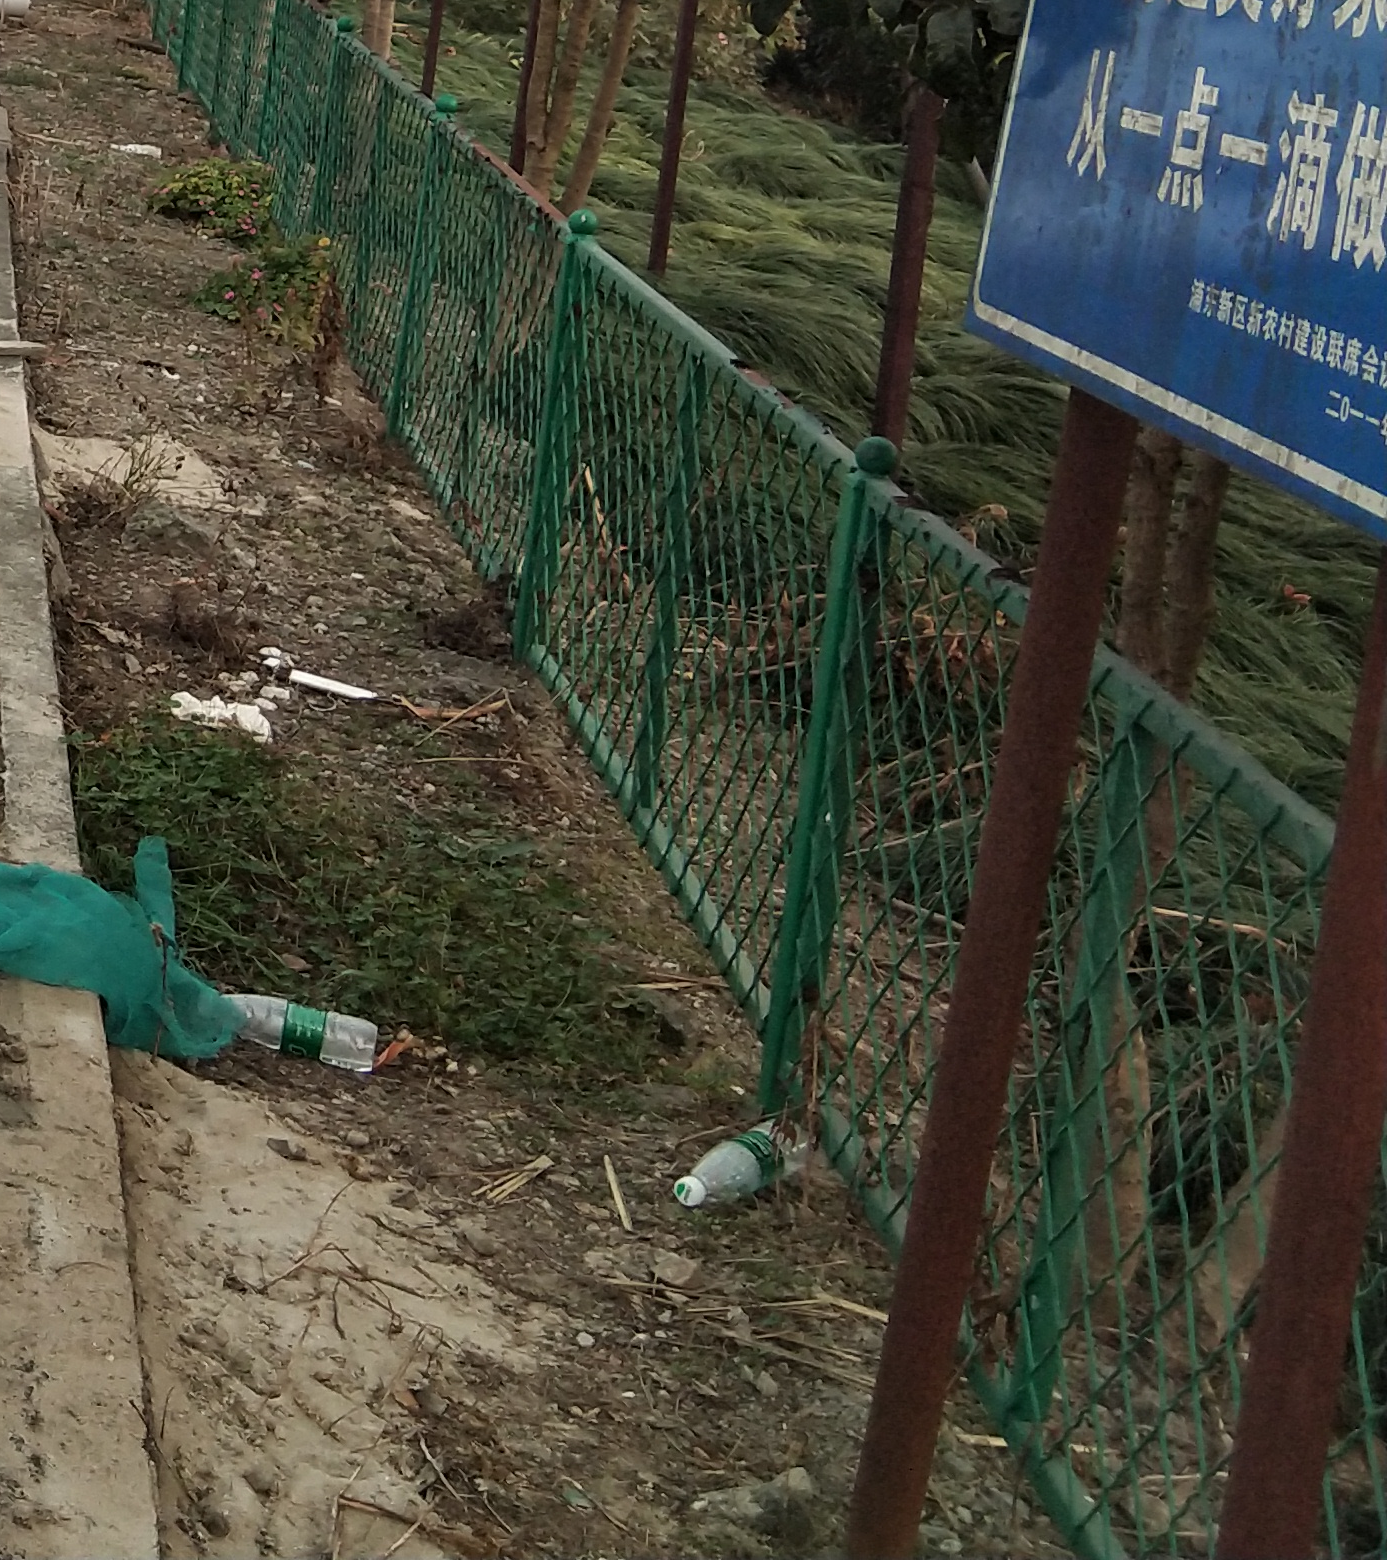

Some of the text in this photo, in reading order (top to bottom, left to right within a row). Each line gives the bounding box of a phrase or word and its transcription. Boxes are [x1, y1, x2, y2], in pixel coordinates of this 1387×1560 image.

[1066, 48, 1387, 272] 从一点一滴做
